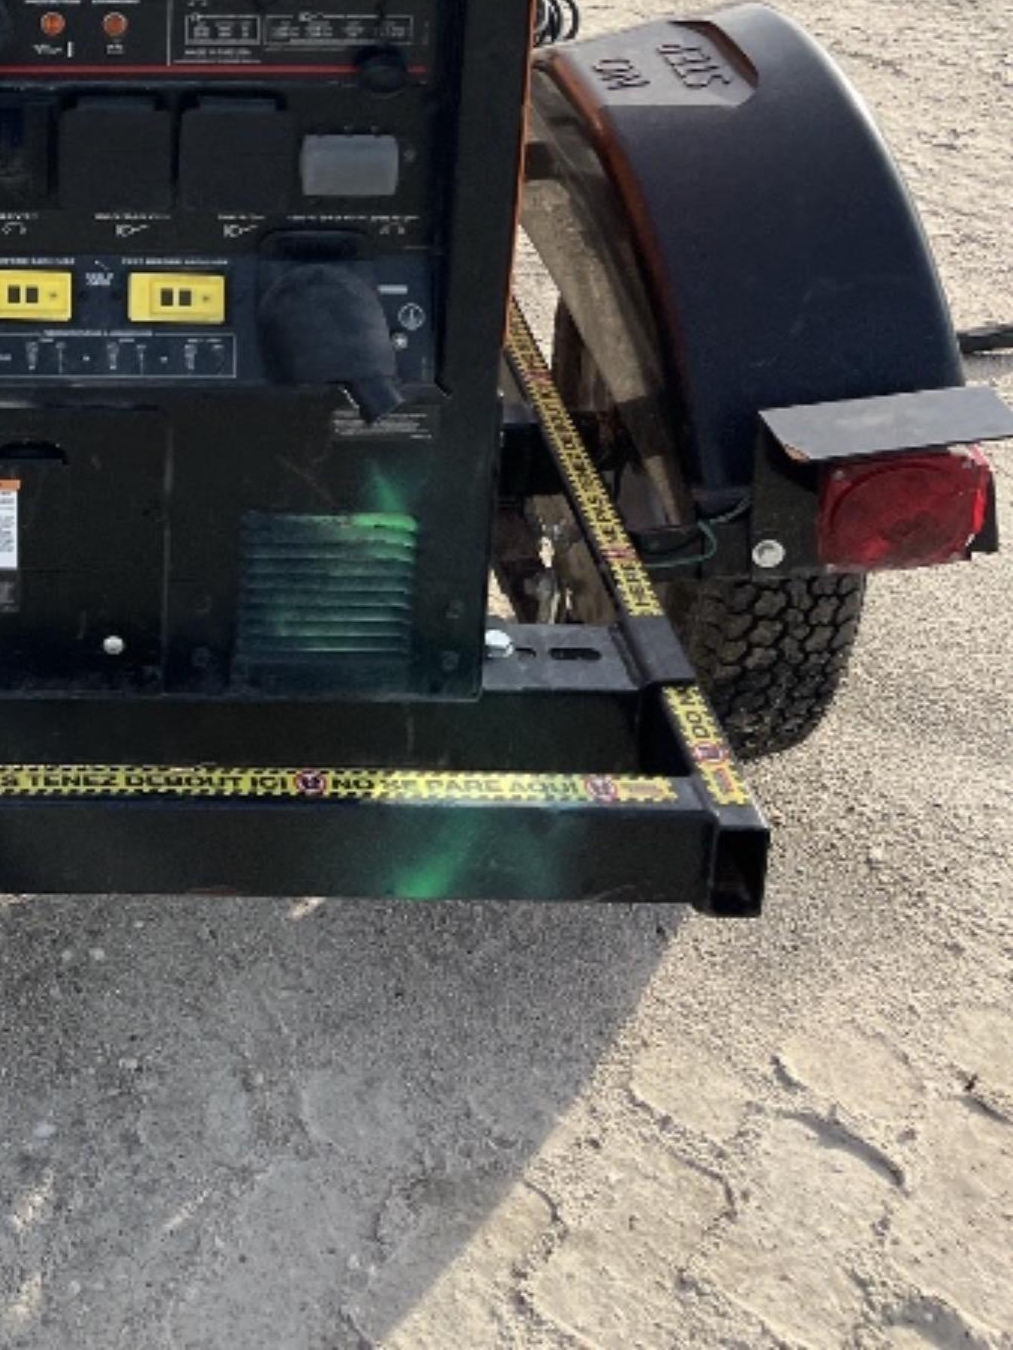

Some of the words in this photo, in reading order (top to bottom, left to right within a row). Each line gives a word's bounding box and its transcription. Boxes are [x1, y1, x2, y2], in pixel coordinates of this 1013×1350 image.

[29, 775, 117, 787] TENEZ
[125, 775, 242, 788] DEBOUT
[332, 778, 374, 789] NO
[427, 780, 502, 792] PARE
